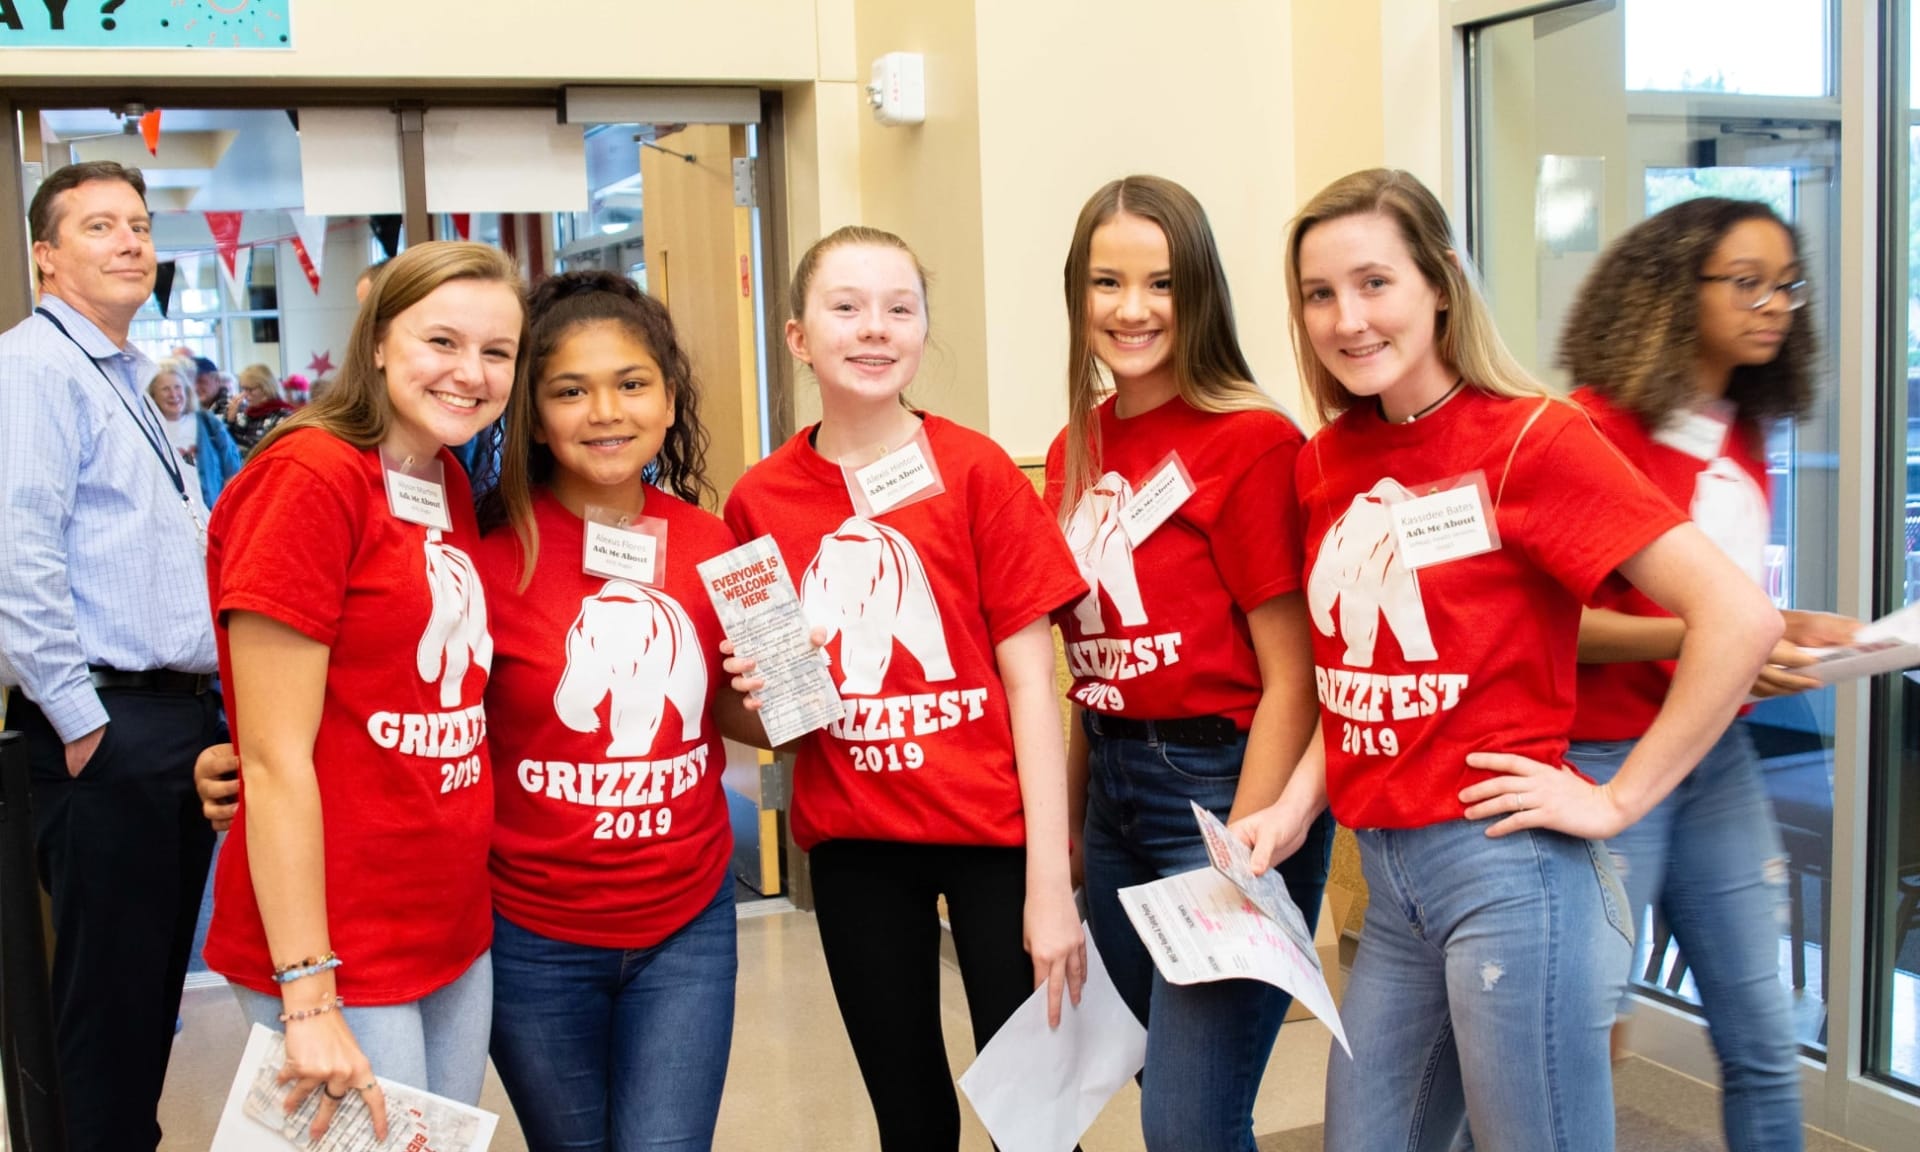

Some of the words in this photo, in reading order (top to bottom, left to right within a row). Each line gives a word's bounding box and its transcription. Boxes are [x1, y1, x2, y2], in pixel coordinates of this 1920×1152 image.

[870, 483, 886, 496] Ask
[885, 477, 898, 488] Me
[898, 463, 924, 481] About
[1401, 509, 1443, 527] Kassidee
[1445, 502, 1474, 517] Bates
[1406, 526, 1426, 539] Ask
[1427, 523, 1441, 534] Me
[1443, 515, 1476, 530] About
[592, 544, 607, 556] Ask
[608, 549, 620, 559] Me
[620, 552, 648, 564] About
[711, 560, 767, 593] EVERYONE
[766, 555, 779, 570] IS
[723, 570, 778, 602] WELCOME
[740, 588, 770, 609] HERE
[1075, 681, 1125, 711] 2019
[1315, 665, 1469, 722] RIZZFEST
[830, 687, 988, 741] ZZFEST
[1342, 721, 1399, 757] 2019
[849, 741, 924, 773] 2019
[440, 754, 481, 794] 2019
[517, 743, 709, 807] GRIZZFEST
[593, 807, 673, 840] 2019
